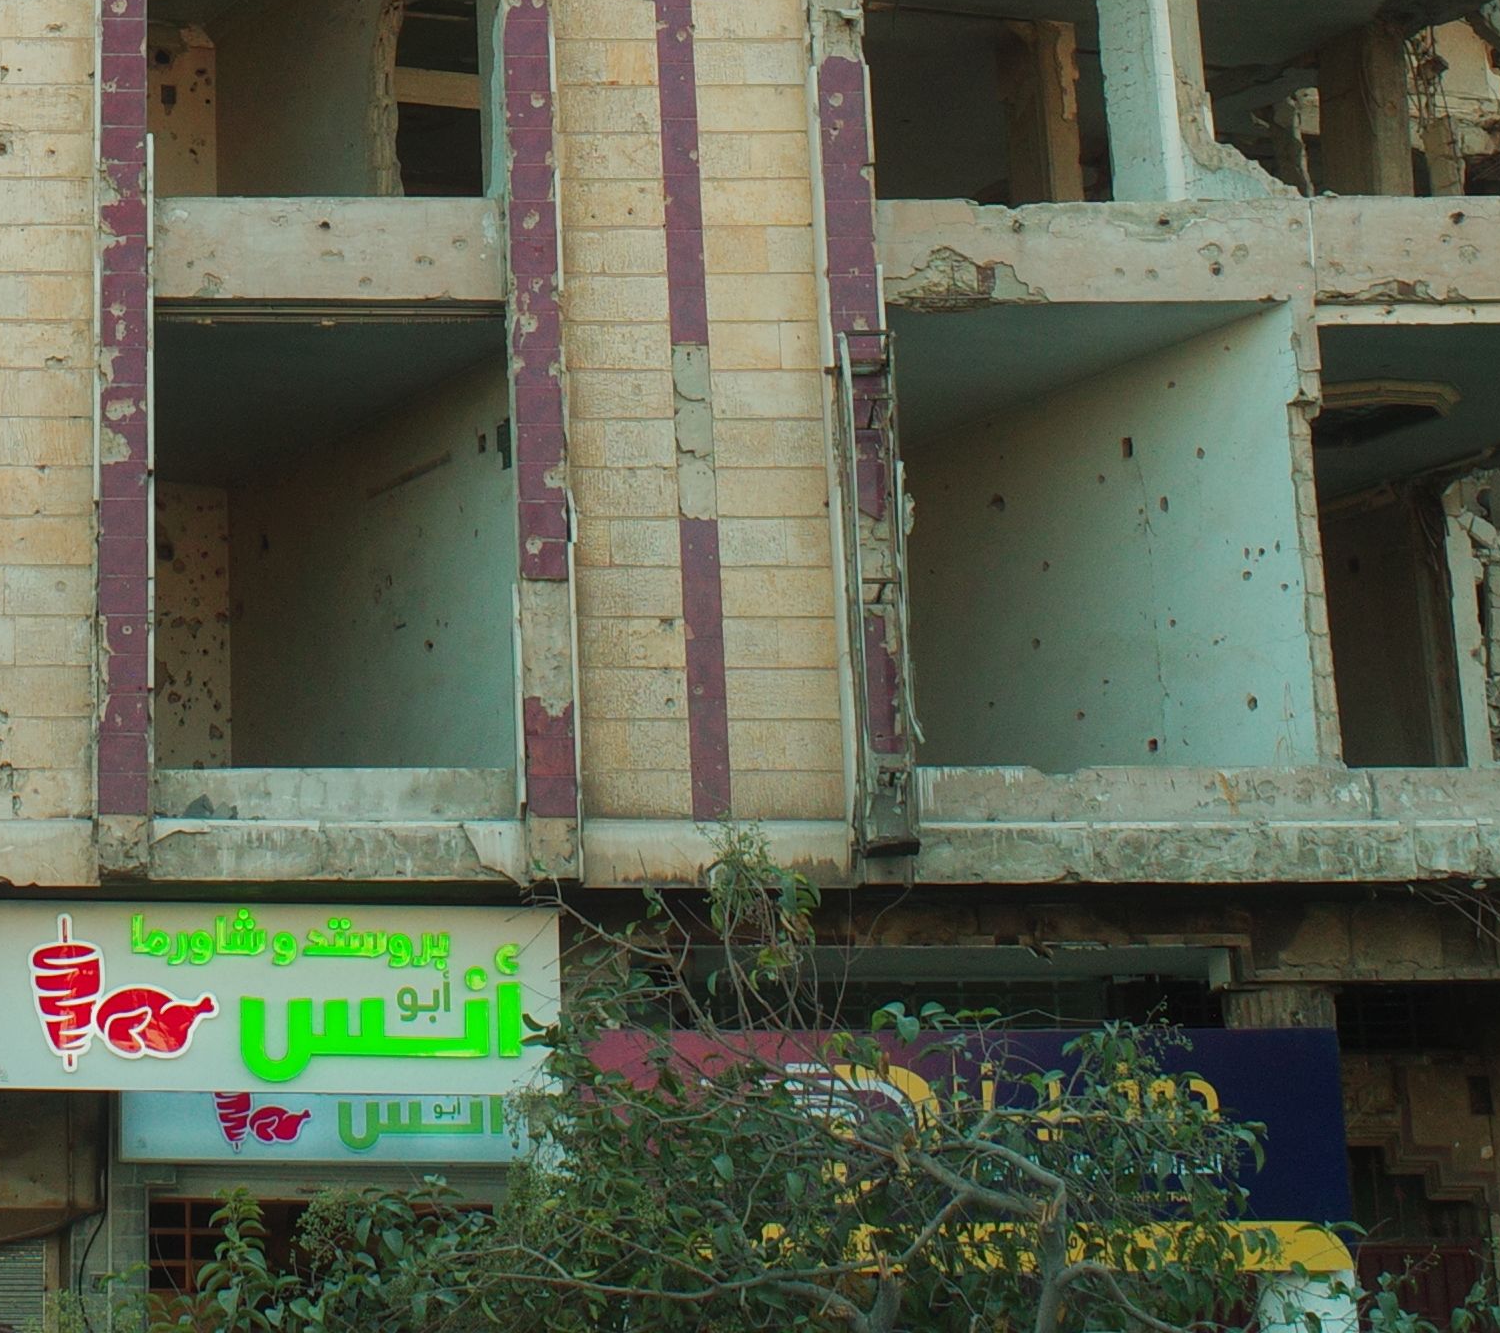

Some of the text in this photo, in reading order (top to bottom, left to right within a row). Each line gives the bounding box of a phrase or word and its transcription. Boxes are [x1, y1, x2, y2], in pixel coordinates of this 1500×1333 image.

[131, 907, 450, 970] بروستد و شاورما
[240, 943, 521, 1082] أبو أنس
